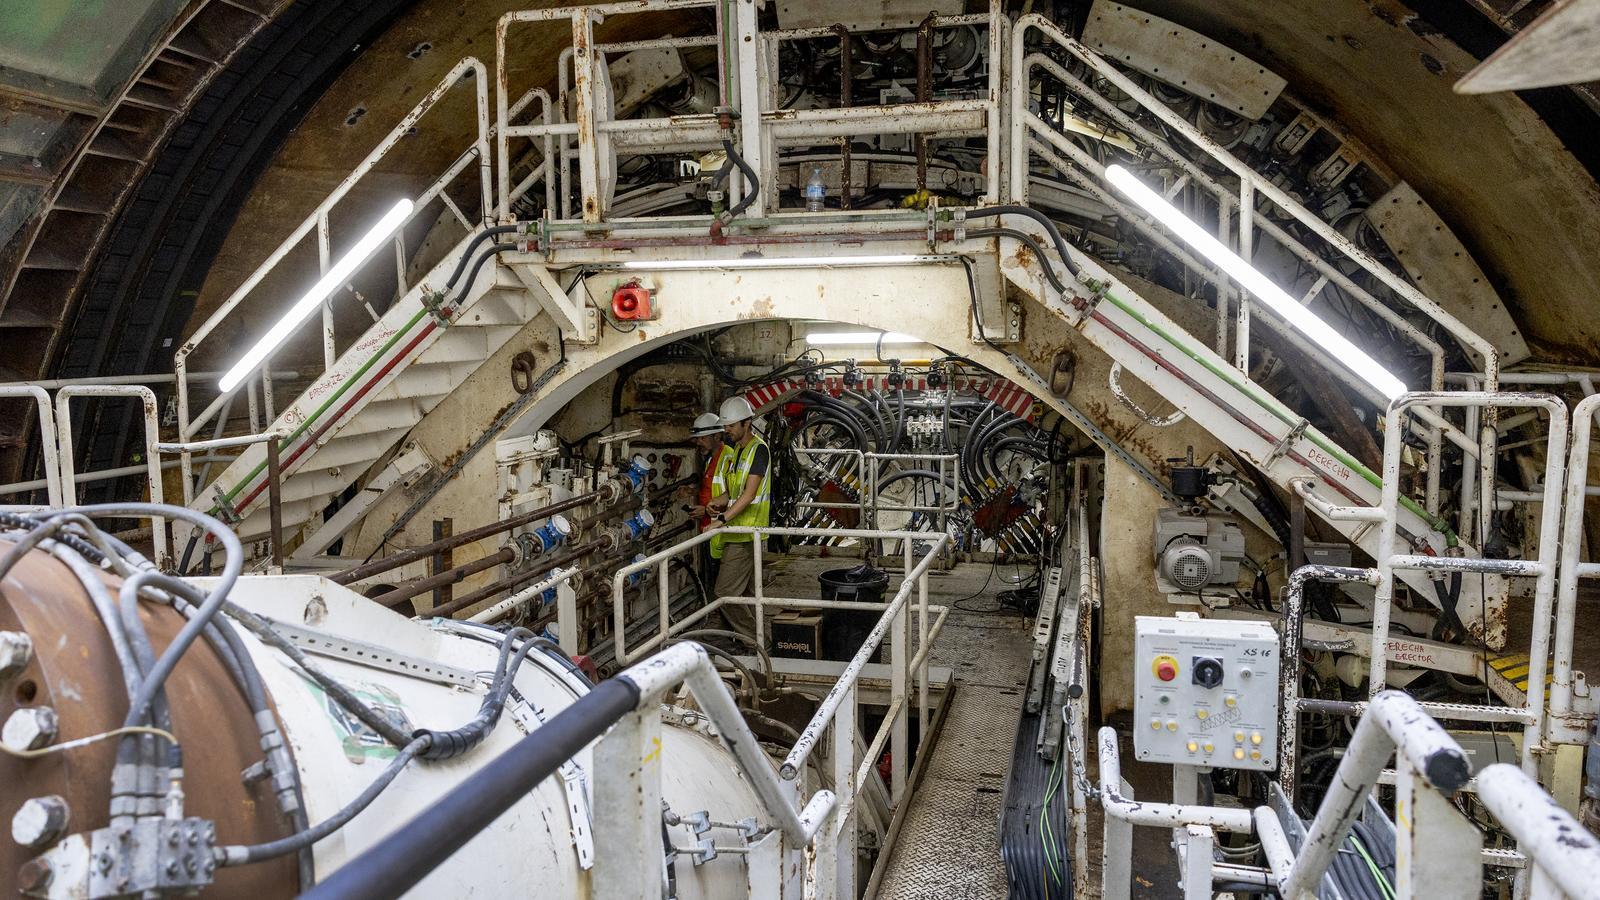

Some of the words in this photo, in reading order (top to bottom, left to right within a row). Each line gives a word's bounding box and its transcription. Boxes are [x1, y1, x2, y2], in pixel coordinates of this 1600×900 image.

[1308, 448, 1350, 480] DERECHA
[1387, 642, 1424, 652] ERECHA
[1395, 653, 1435, 664] ERECTOR
